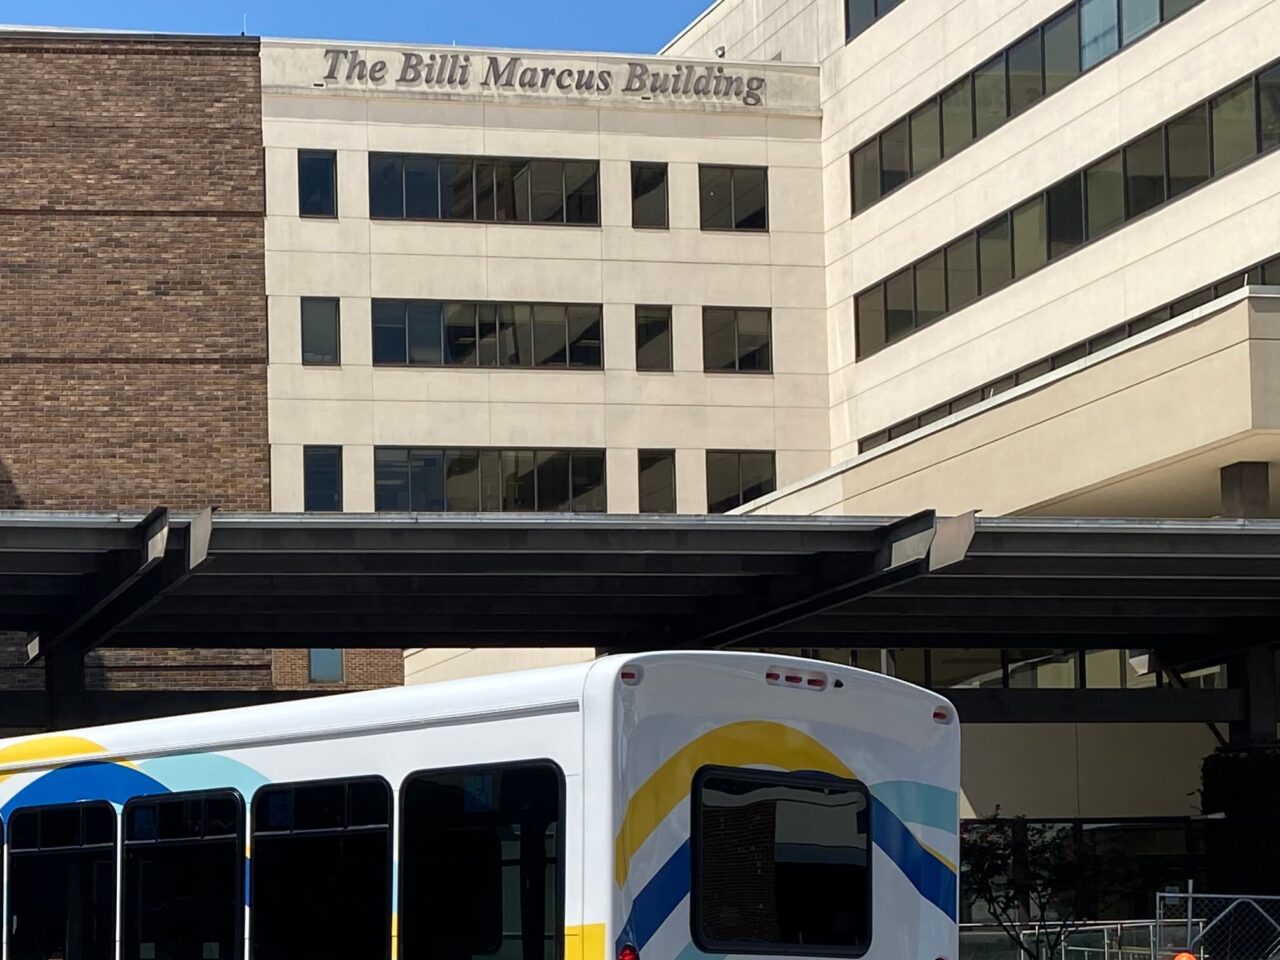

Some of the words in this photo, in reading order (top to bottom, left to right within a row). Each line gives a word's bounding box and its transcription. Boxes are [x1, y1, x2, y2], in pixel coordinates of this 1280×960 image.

[323, 49, 386, 83] The
[396, 52, 471, 85] Billi
[480, 56, 612, 91] Marcus
[622, 62, 766, 106] Building
